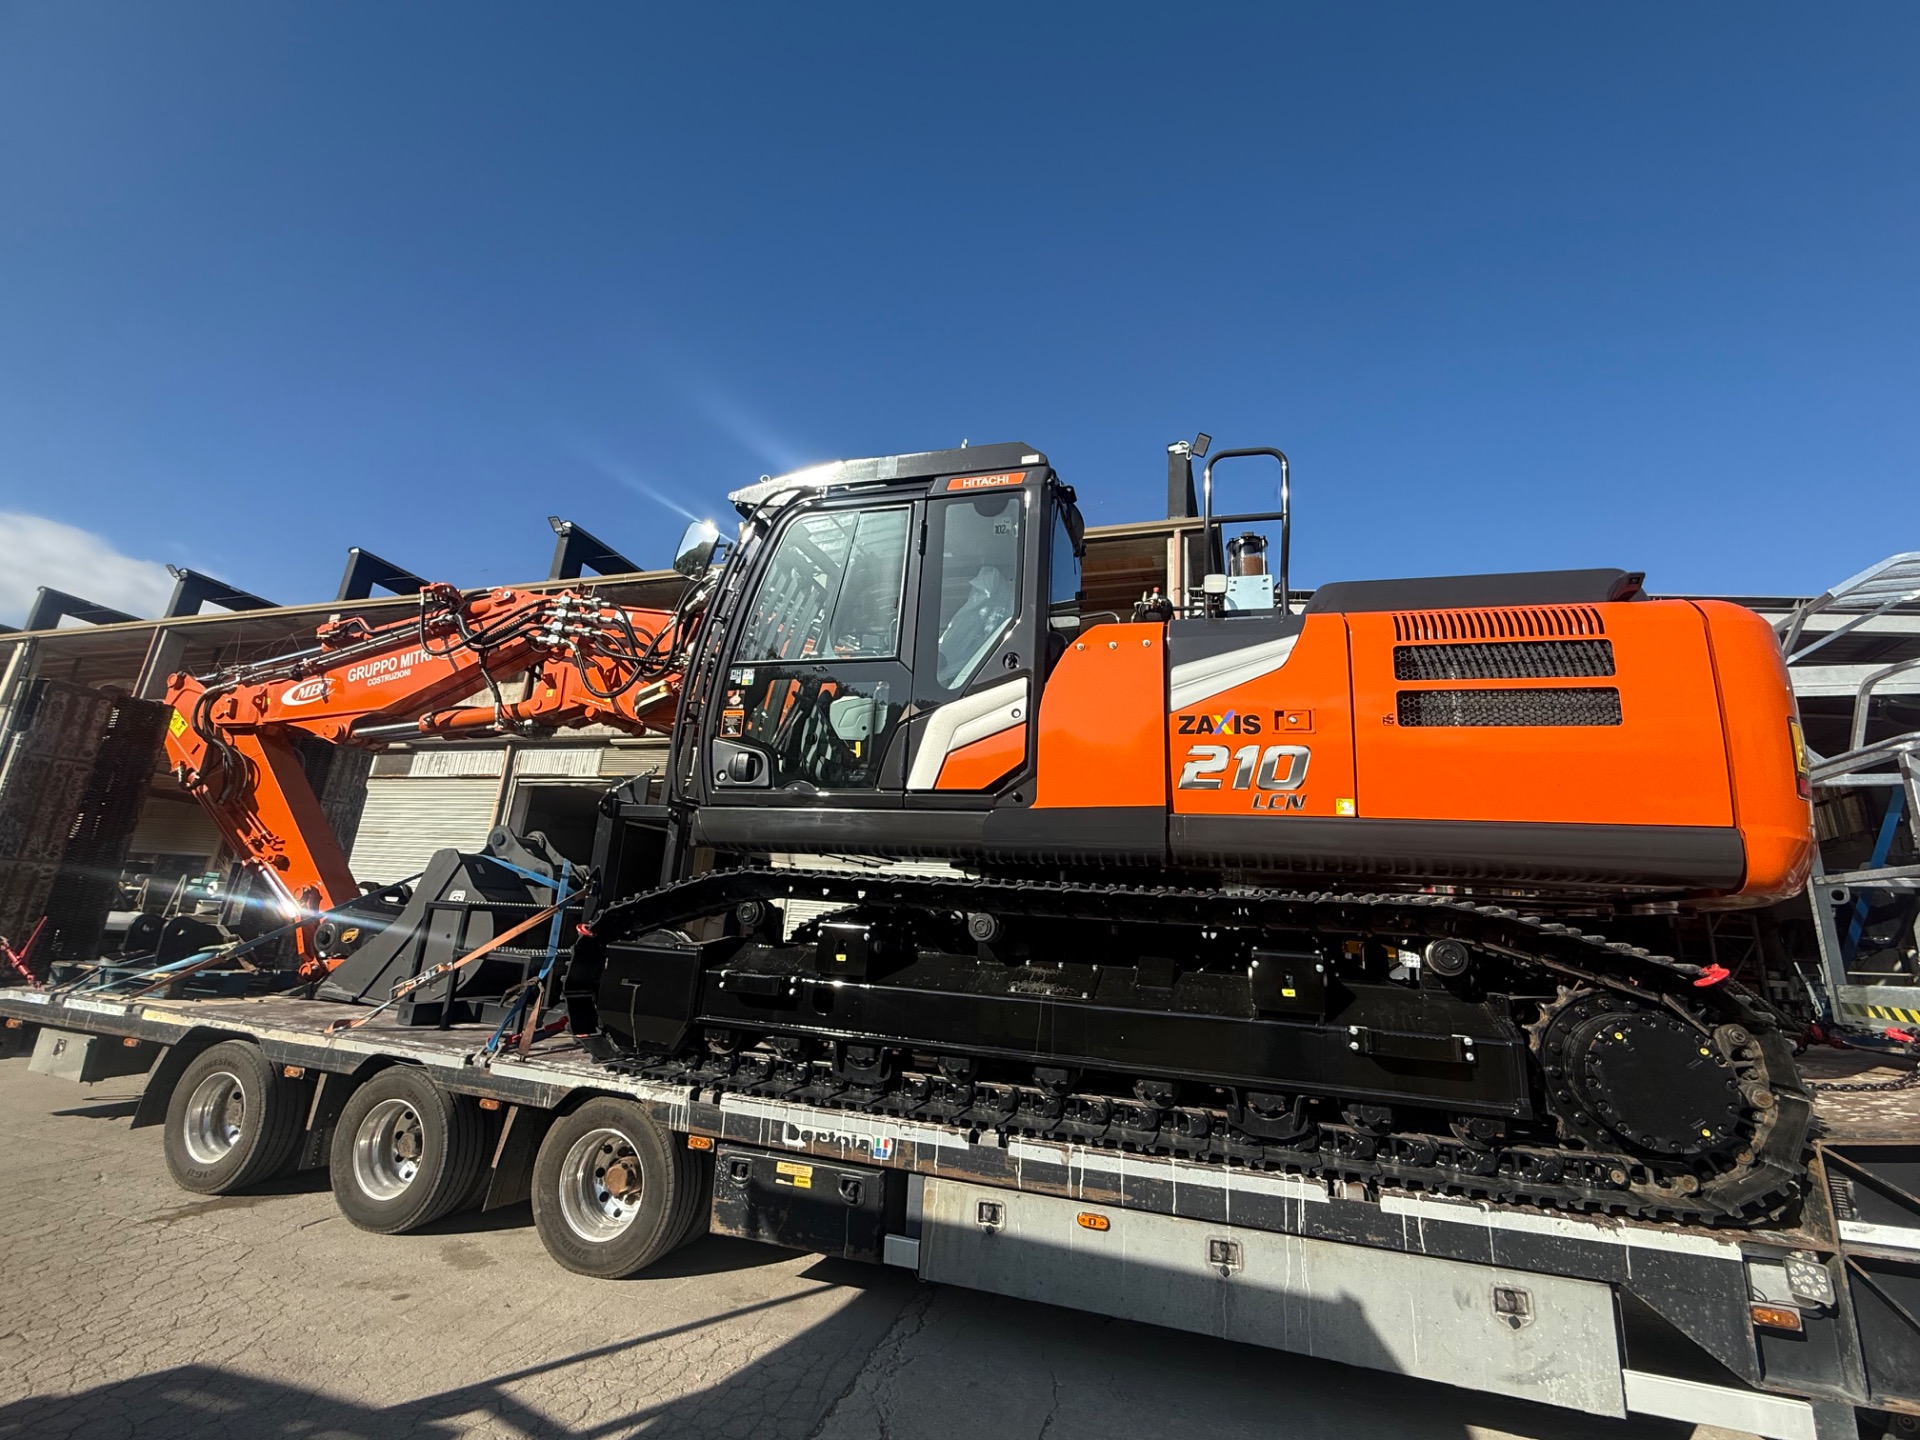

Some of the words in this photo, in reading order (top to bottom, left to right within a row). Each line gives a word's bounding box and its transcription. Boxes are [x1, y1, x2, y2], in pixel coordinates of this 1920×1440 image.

[963, 475, 1009, 488] HITACHI
[994, 524, 1007, 535] 102
[347, 656, 398, 683] GRUPPO
[366, 668, 412, 687] COSTRUZIONI
[1178, 709, 1261, 735] ZAXIS
[1177, 744, 1312, 791] 210
[1251, 793, 1307, 811] LCN
